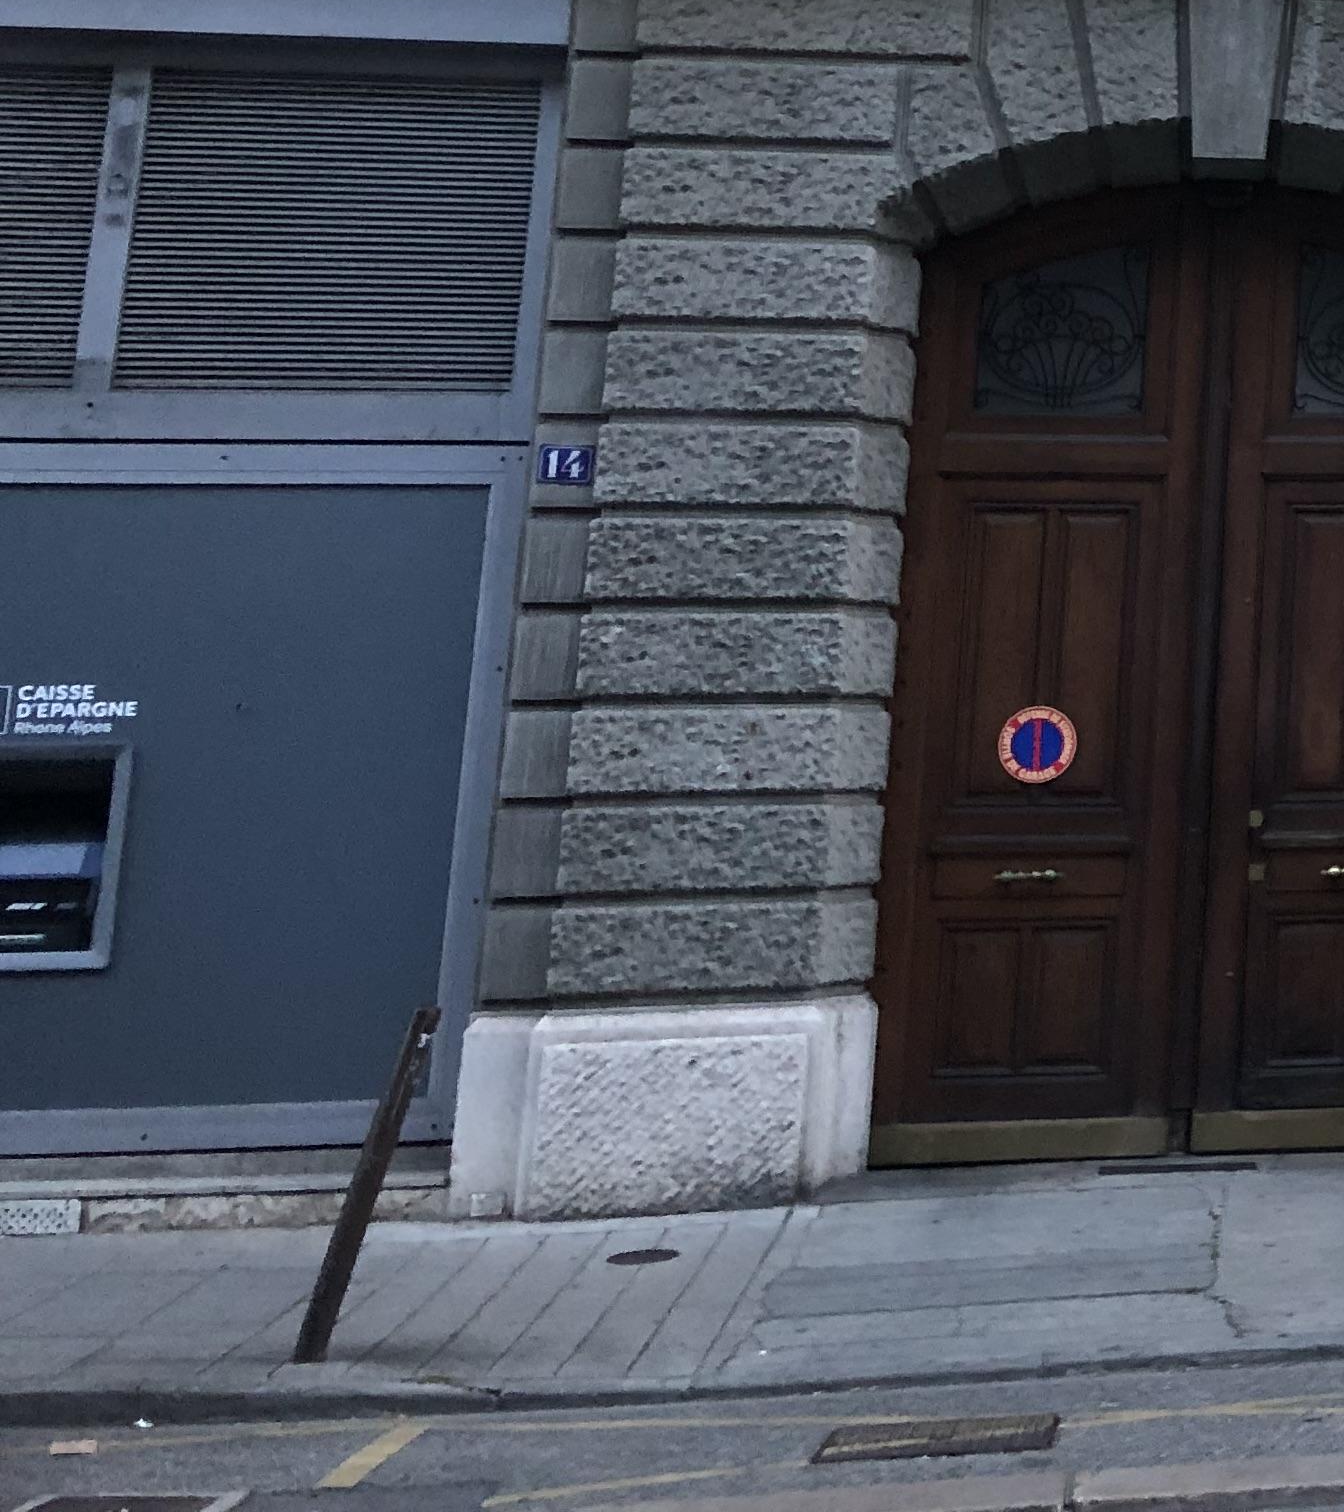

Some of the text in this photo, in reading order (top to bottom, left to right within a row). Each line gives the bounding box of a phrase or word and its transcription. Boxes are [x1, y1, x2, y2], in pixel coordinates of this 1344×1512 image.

[546, 449, 585, 479] 14
[18, 684, 97, 701] CAISSE
[66, 719, 113, 736] Alpes
